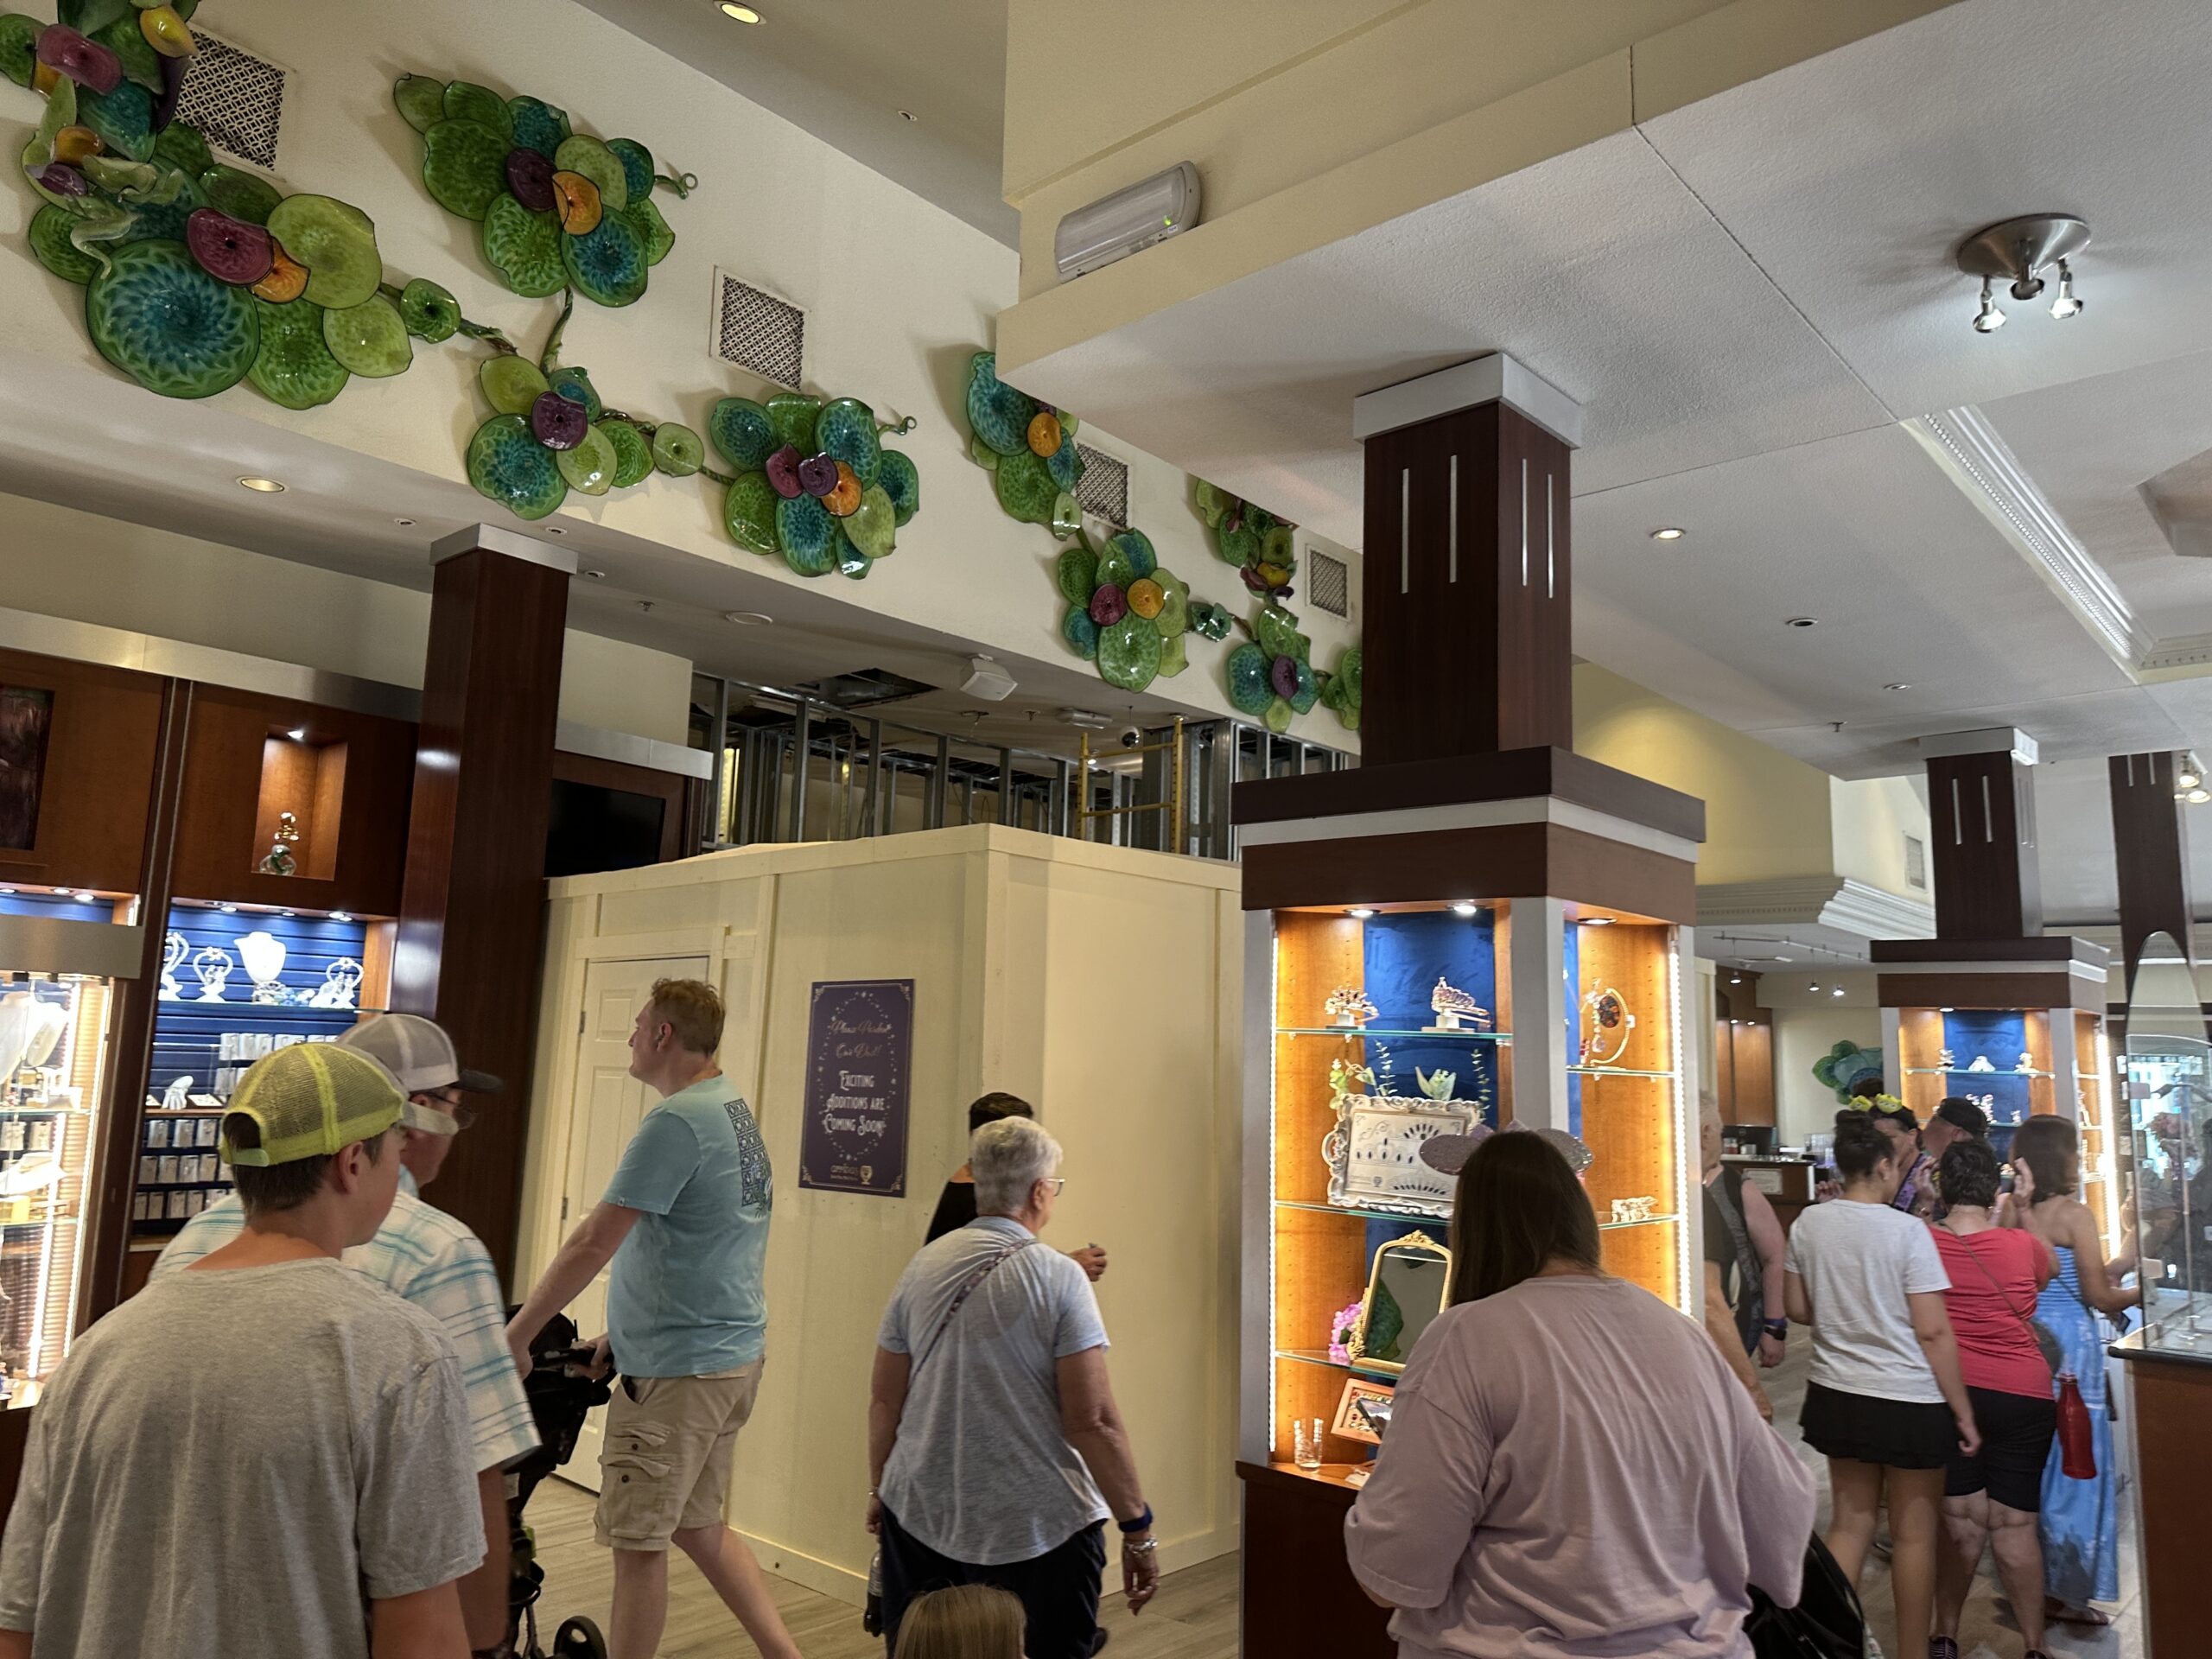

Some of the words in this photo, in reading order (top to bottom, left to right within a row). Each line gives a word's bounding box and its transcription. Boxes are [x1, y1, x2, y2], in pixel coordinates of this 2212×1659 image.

[839, 1070, 874, 1091] EXCITING
[869, 1097, 886, 1110] ARE
[823, 1113, 856, 1133] COMING
